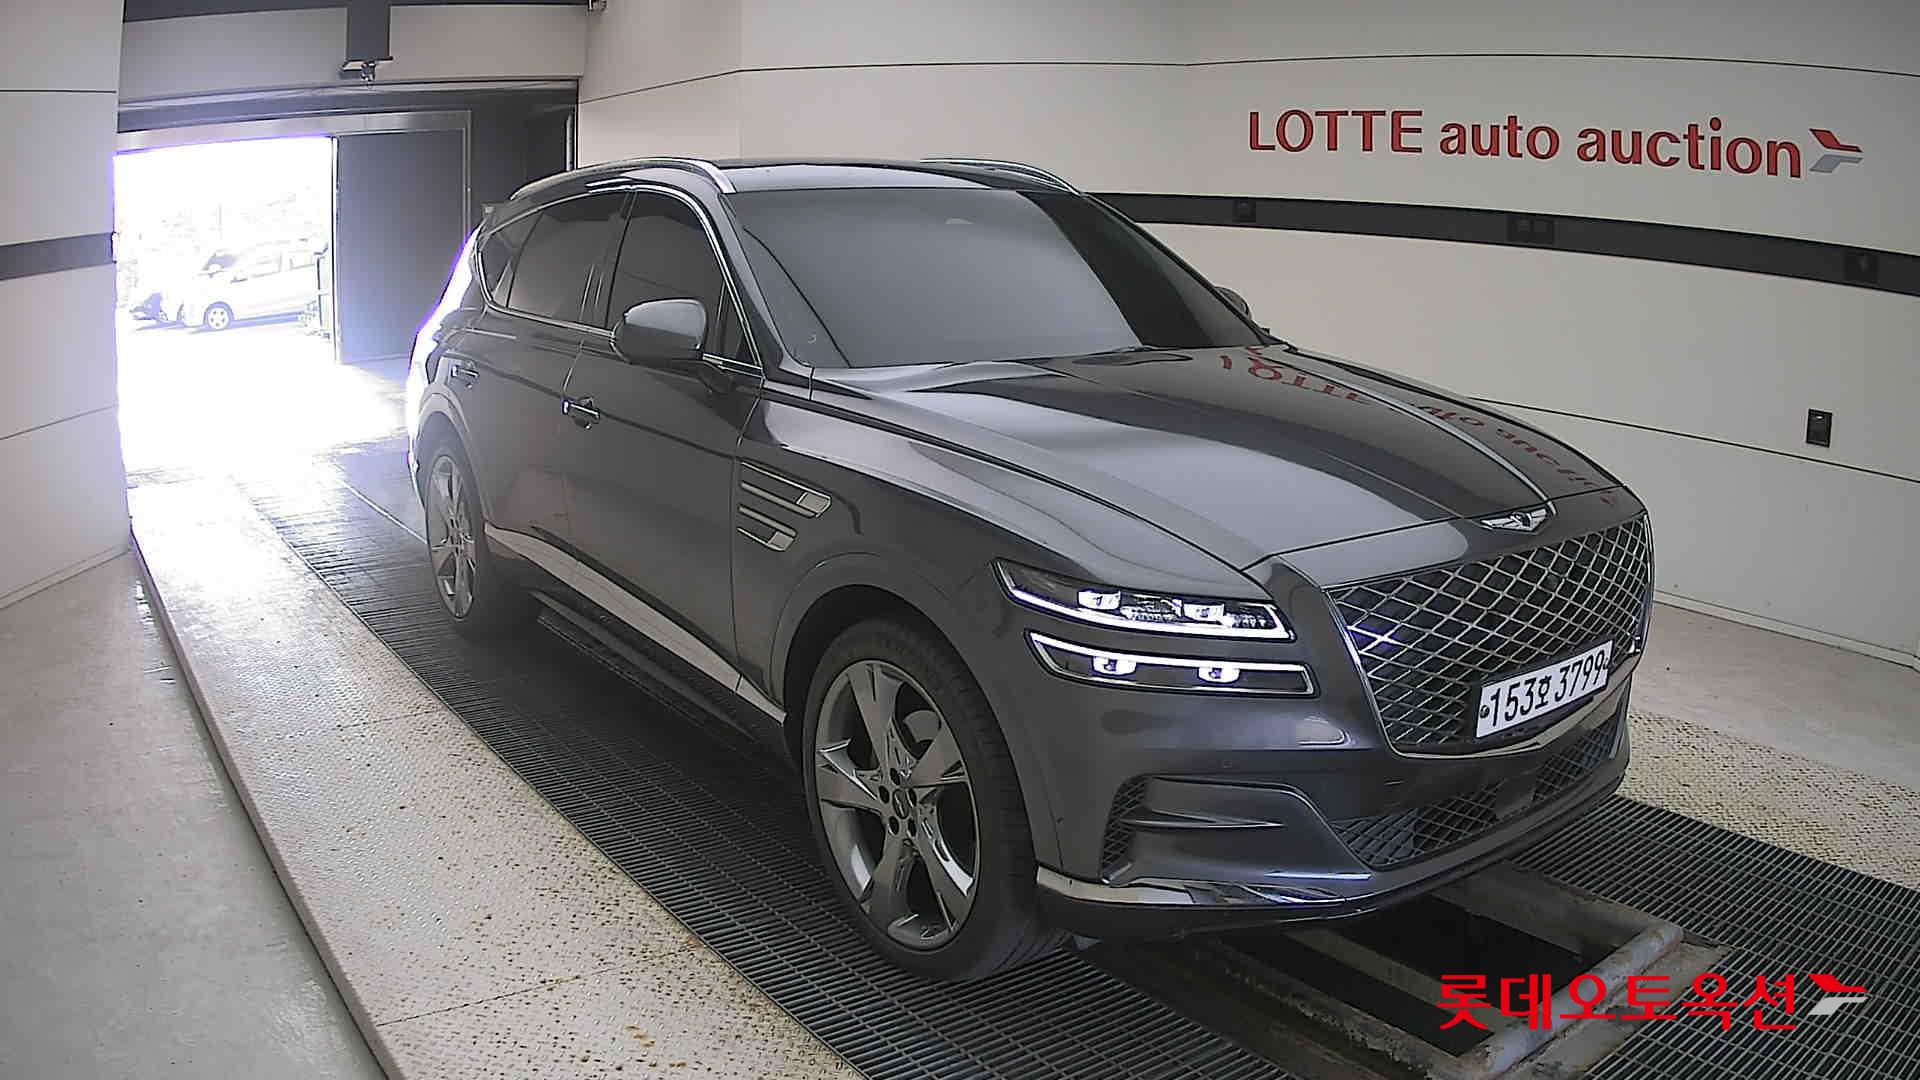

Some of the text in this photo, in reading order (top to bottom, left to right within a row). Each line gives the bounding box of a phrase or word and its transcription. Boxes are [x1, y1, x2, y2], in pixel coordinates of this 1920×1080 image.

[1249, 110, 1802, 178] LOTTE auto auction
[1554, 649, 1606, 702] 3799
